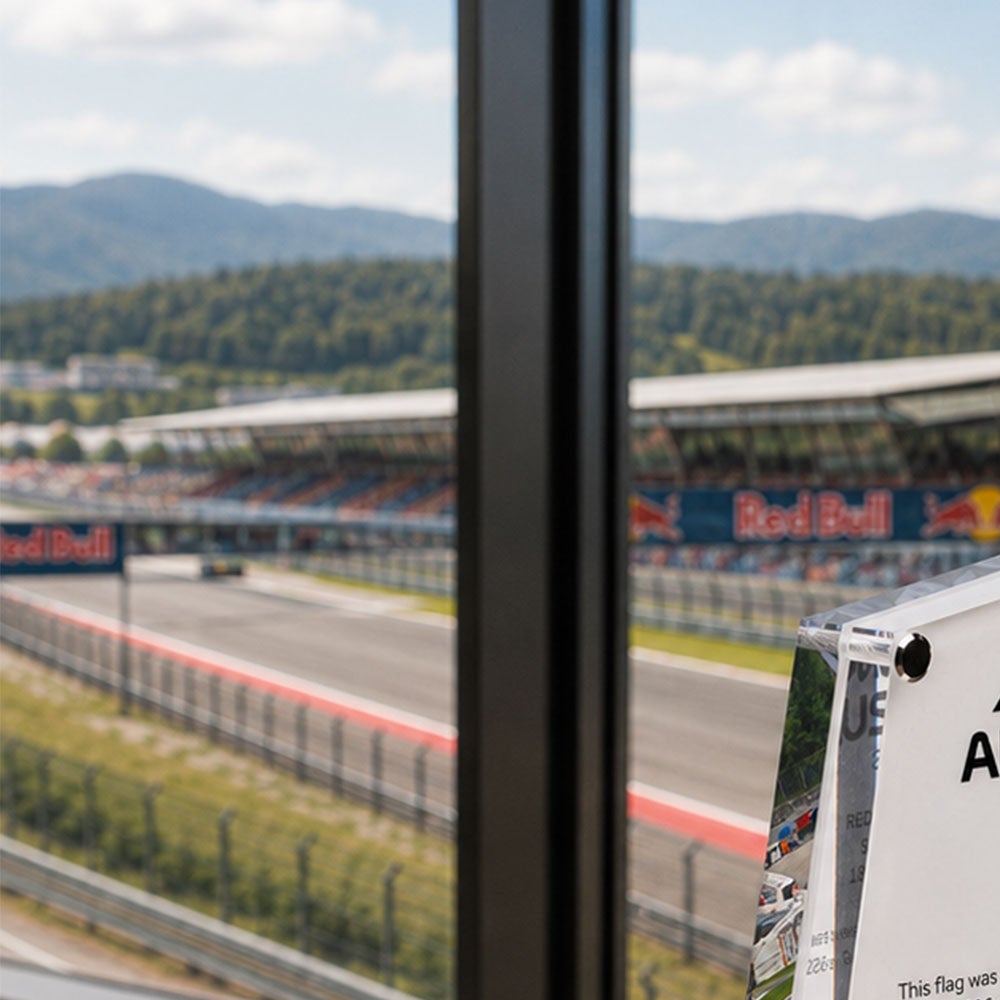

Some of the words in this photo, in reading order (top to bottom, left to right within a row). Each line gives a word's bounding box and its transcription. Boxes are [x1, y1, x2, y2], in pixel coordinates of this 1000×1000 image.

[734, 490, 812, 540] Red
[818, 490, 893, 540] Bull
[0, 525, 45, 563] ed
[50, 525, 115, 563] Bull
[898, 979, 931, 1000] This
[935, 971, 965, 996] flag
[968, 971, 998, 990] was
